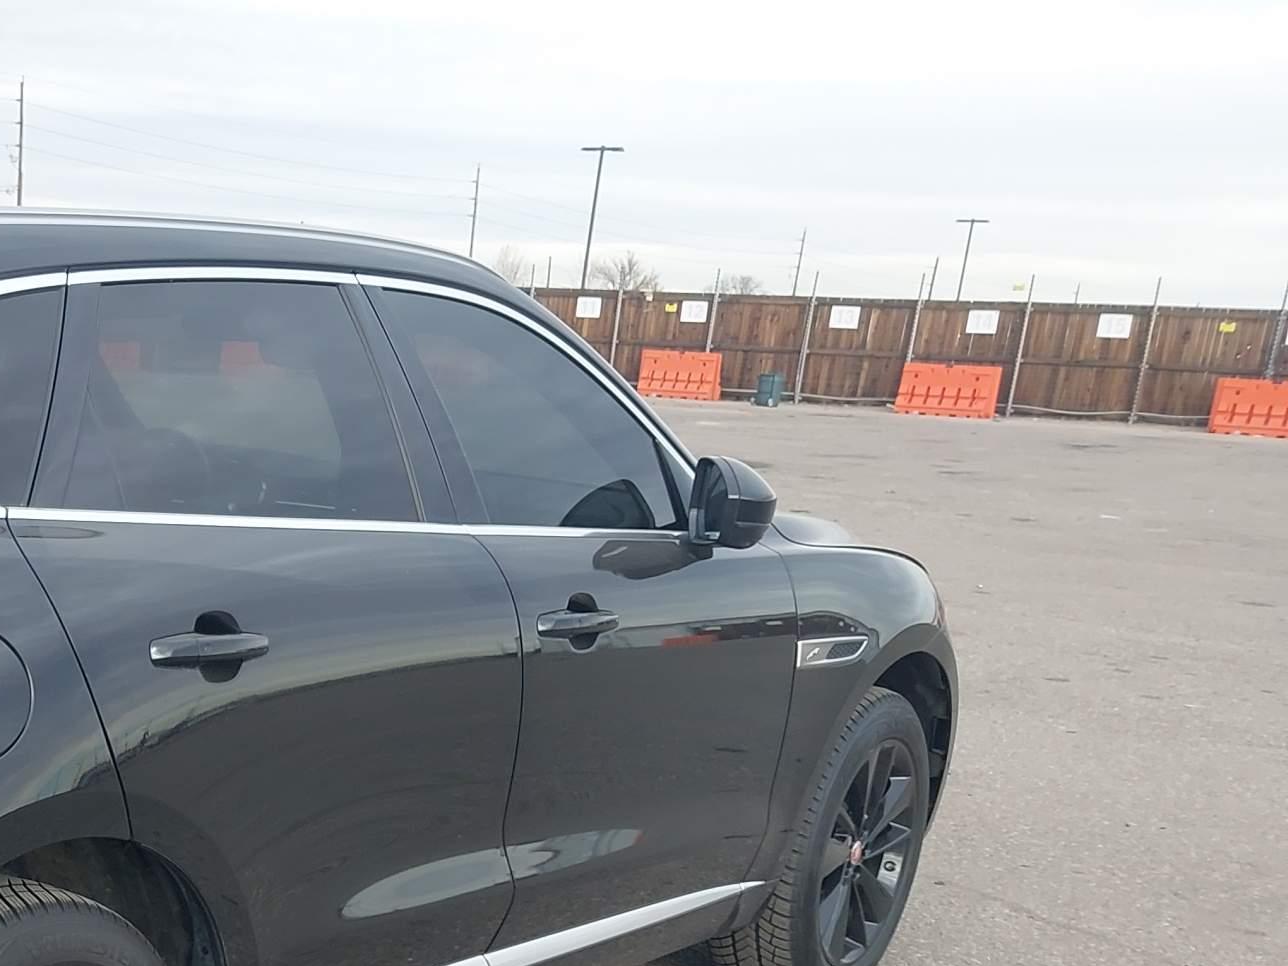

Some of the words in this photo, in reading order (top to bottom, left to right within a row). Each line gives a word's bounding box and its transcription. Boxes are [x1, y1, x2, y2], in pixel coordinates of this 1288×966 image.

[581, 300, 596, 315] 11
[688, 304, 704, 319] 12
[837, 309, 855, 325] 13
[975, 314, 993, 330] 14
[1107, 317, 1126, 334] 15
